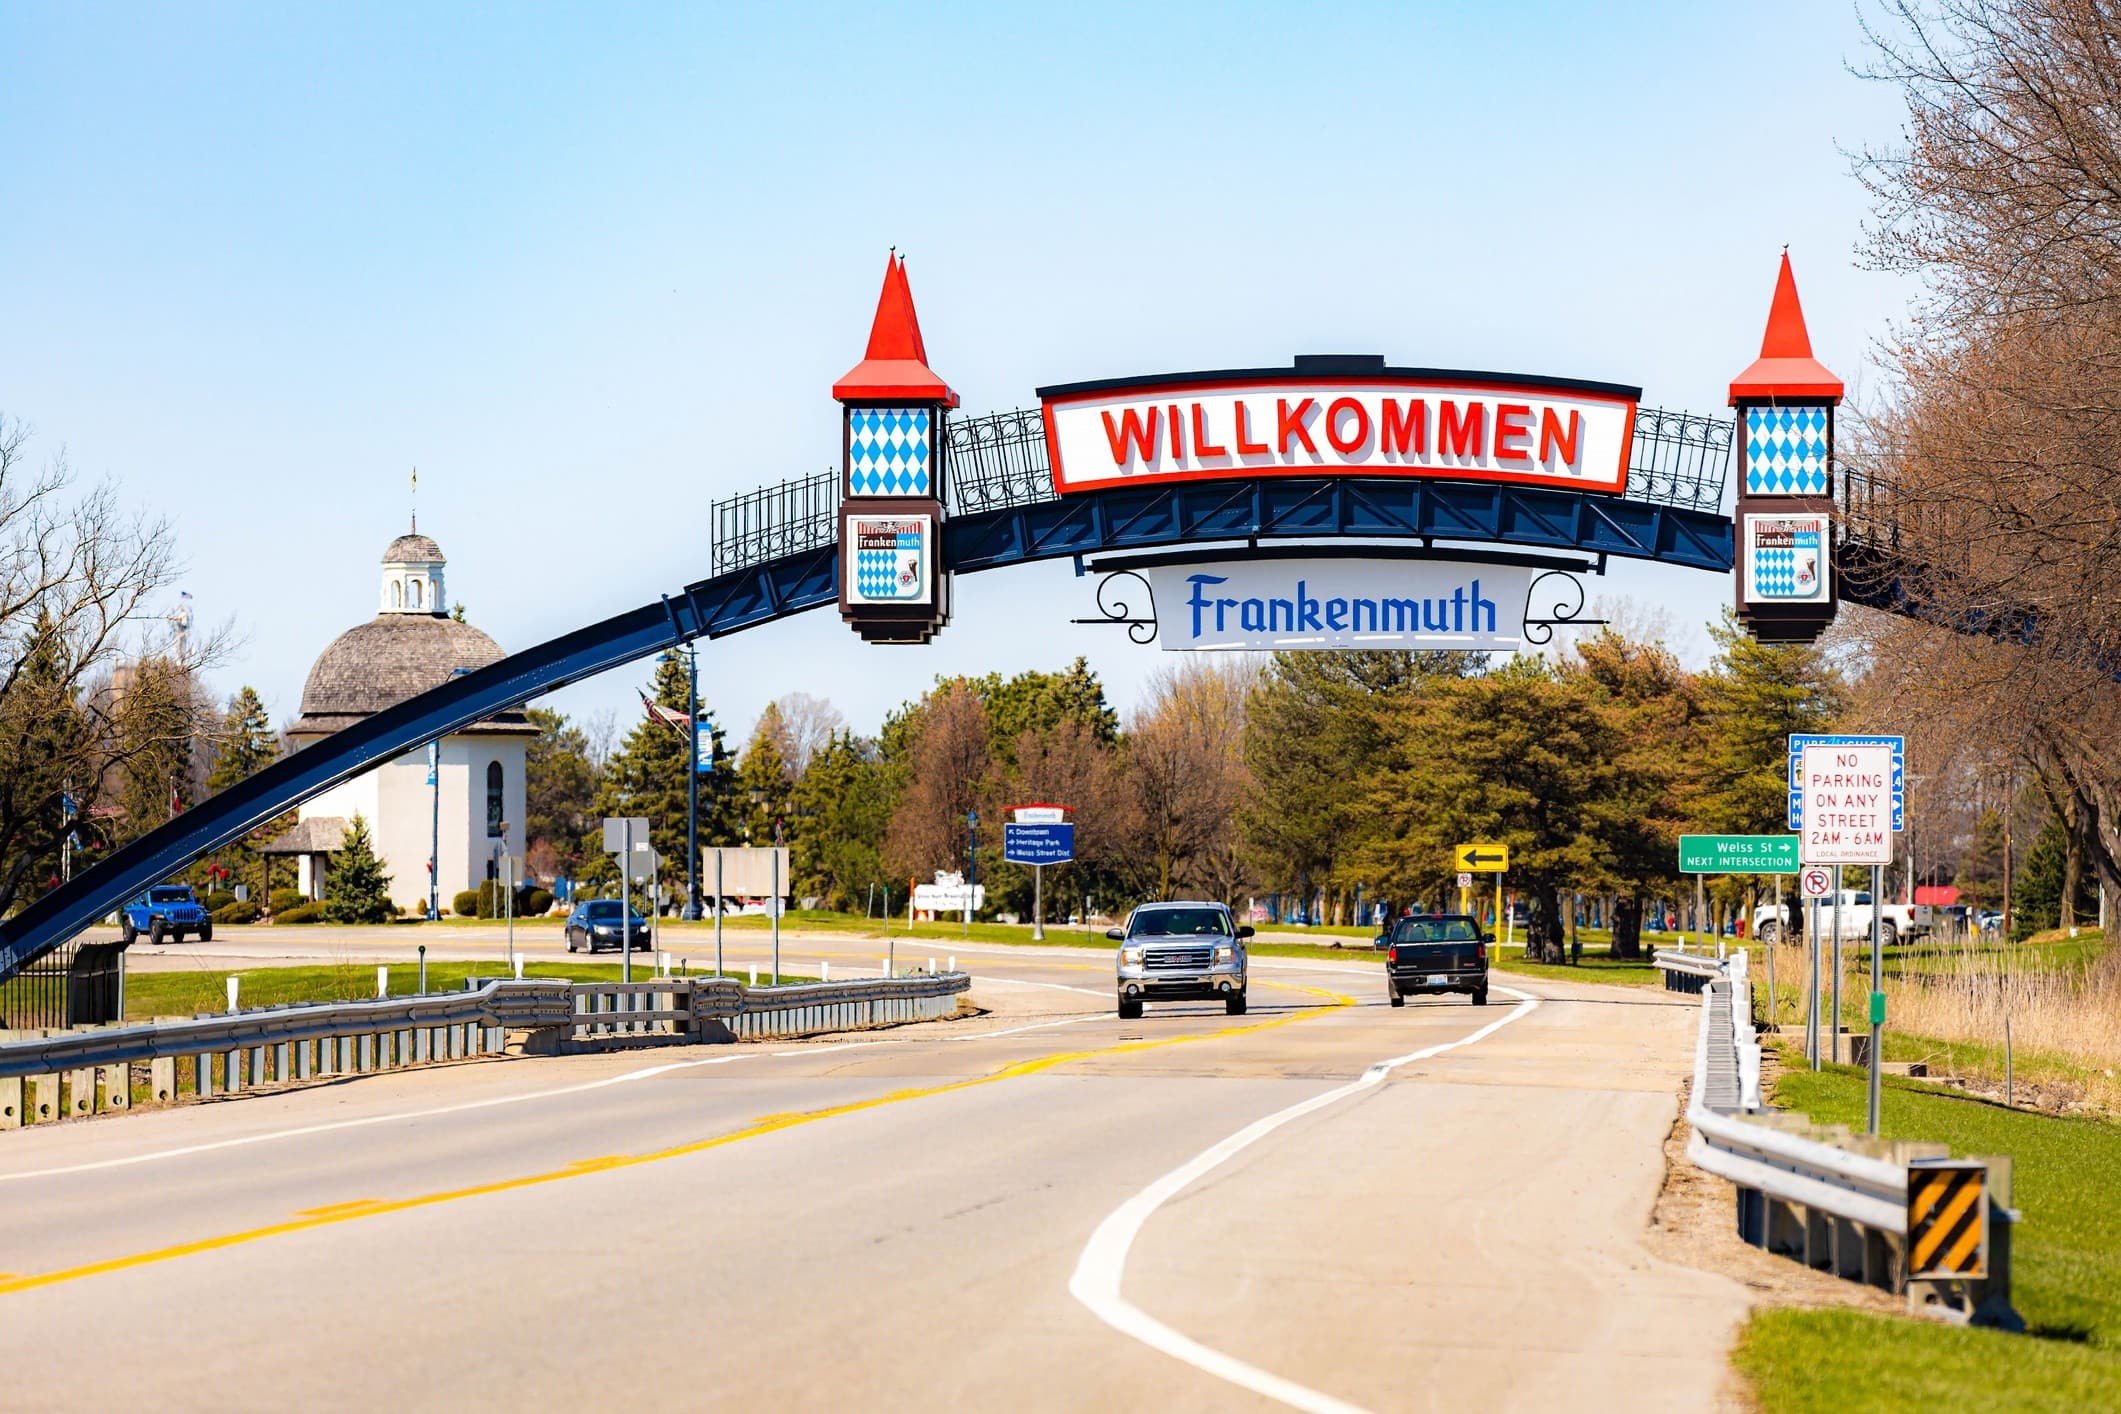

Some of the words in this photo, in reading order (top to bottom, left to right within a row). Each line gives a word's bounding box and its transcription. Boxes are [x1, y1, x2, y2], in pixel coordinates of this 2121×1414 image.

[1101, 397, 1580, 466] WILLKOMMEN
[859, 535, 920, 548] Frankenmuth
[1756, 533, 1818, 547] Frankenmuth
[1185, 574, 1496, 639] Frankenmuth
[1836, 754, 1858, 767] NO
[1812, 774, 1883, 788] PARKING
[1816, 794, 1837, 807] ON
[1844, 794, 1878, 808] ANY
[1818, 814, 1878, 828] STREET
[1811, 831, 1841, 845] 2AM
[1854, 831, 1884, 845] 6AM
[1717, 842, 1753, 853] Weiss
[1760, 842, 1772, 853] St
[1816, 850, 1838, 858] LOCAL
[1840, 850, 1878, 858] ORDINANCE
[1687, 856, 1714, 867] NEXT
[1719, 856, 1793, 867] INTERSECTION
